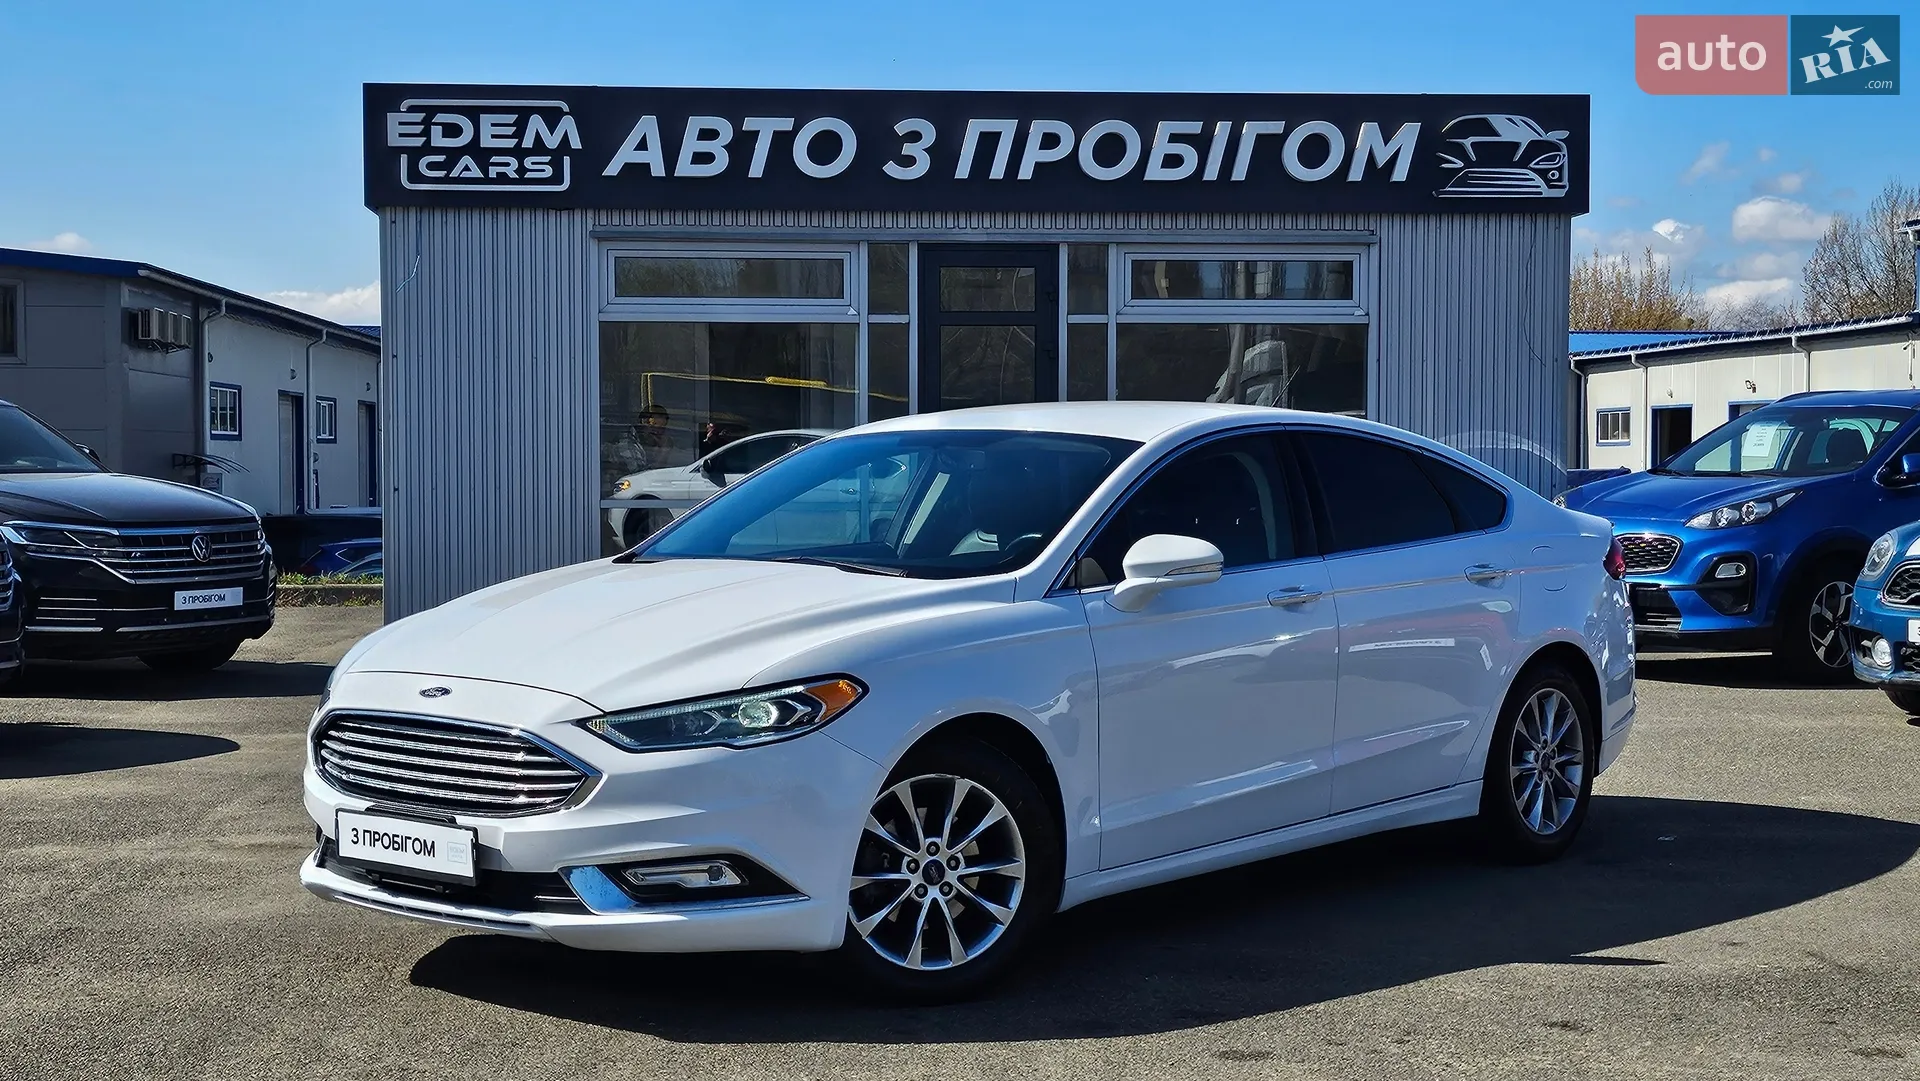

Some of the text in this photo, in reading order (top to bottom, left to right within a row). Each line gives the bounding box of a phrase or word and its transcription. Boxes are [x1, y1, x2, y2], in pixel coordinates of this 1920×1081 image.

[386, 112, 582, 150] EDEM
[602, 115, 857, 179] АВТО
[954, 119, 1421, 182] ПРОБІГОМ
[418, 154, 553, 178] CARS
[188, 593, 226, 604] ПРОБІГОМ
[362, 829, 436, 858] ПРОБІГОМ
